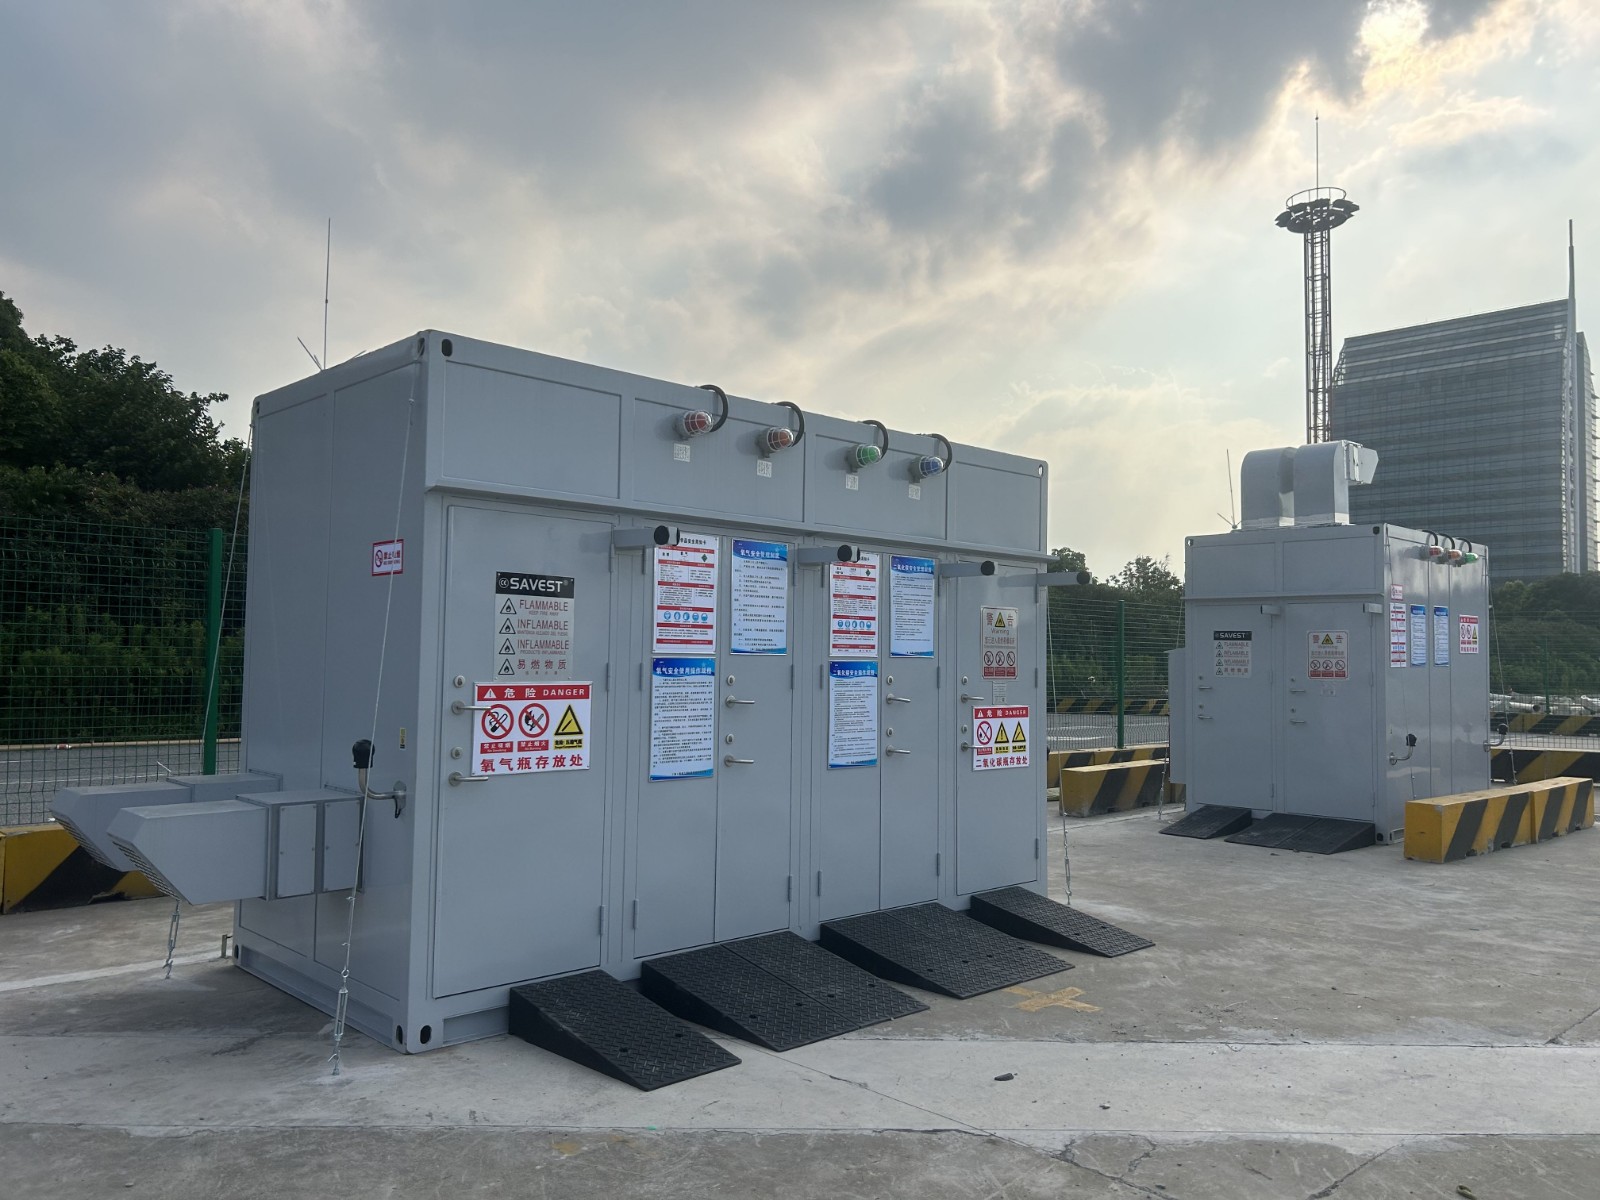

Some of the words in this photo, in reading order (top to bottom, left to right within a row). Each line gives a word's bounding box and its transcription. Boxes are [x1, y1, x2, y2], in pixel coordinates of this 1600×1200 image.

[510, 577, 563, 593] SAVEST
[519, 599, 568, 612] FLAMMABLE
[517, 619, 568, 631] INFLAMABLE
[517, 639, 569, 650] INFLAMMABLE
[517, 659, 566, 670] 易燃物质
[504, 687, 537, 699] 危险
[543, 688, 585, 697] DANGER
[520, 740, 546, 748] 禁止烟火
[480, 754, 583, 773] 氧气瓶存放处
[976, 755, 1028, 768] 二氧化碳瓶存放处
